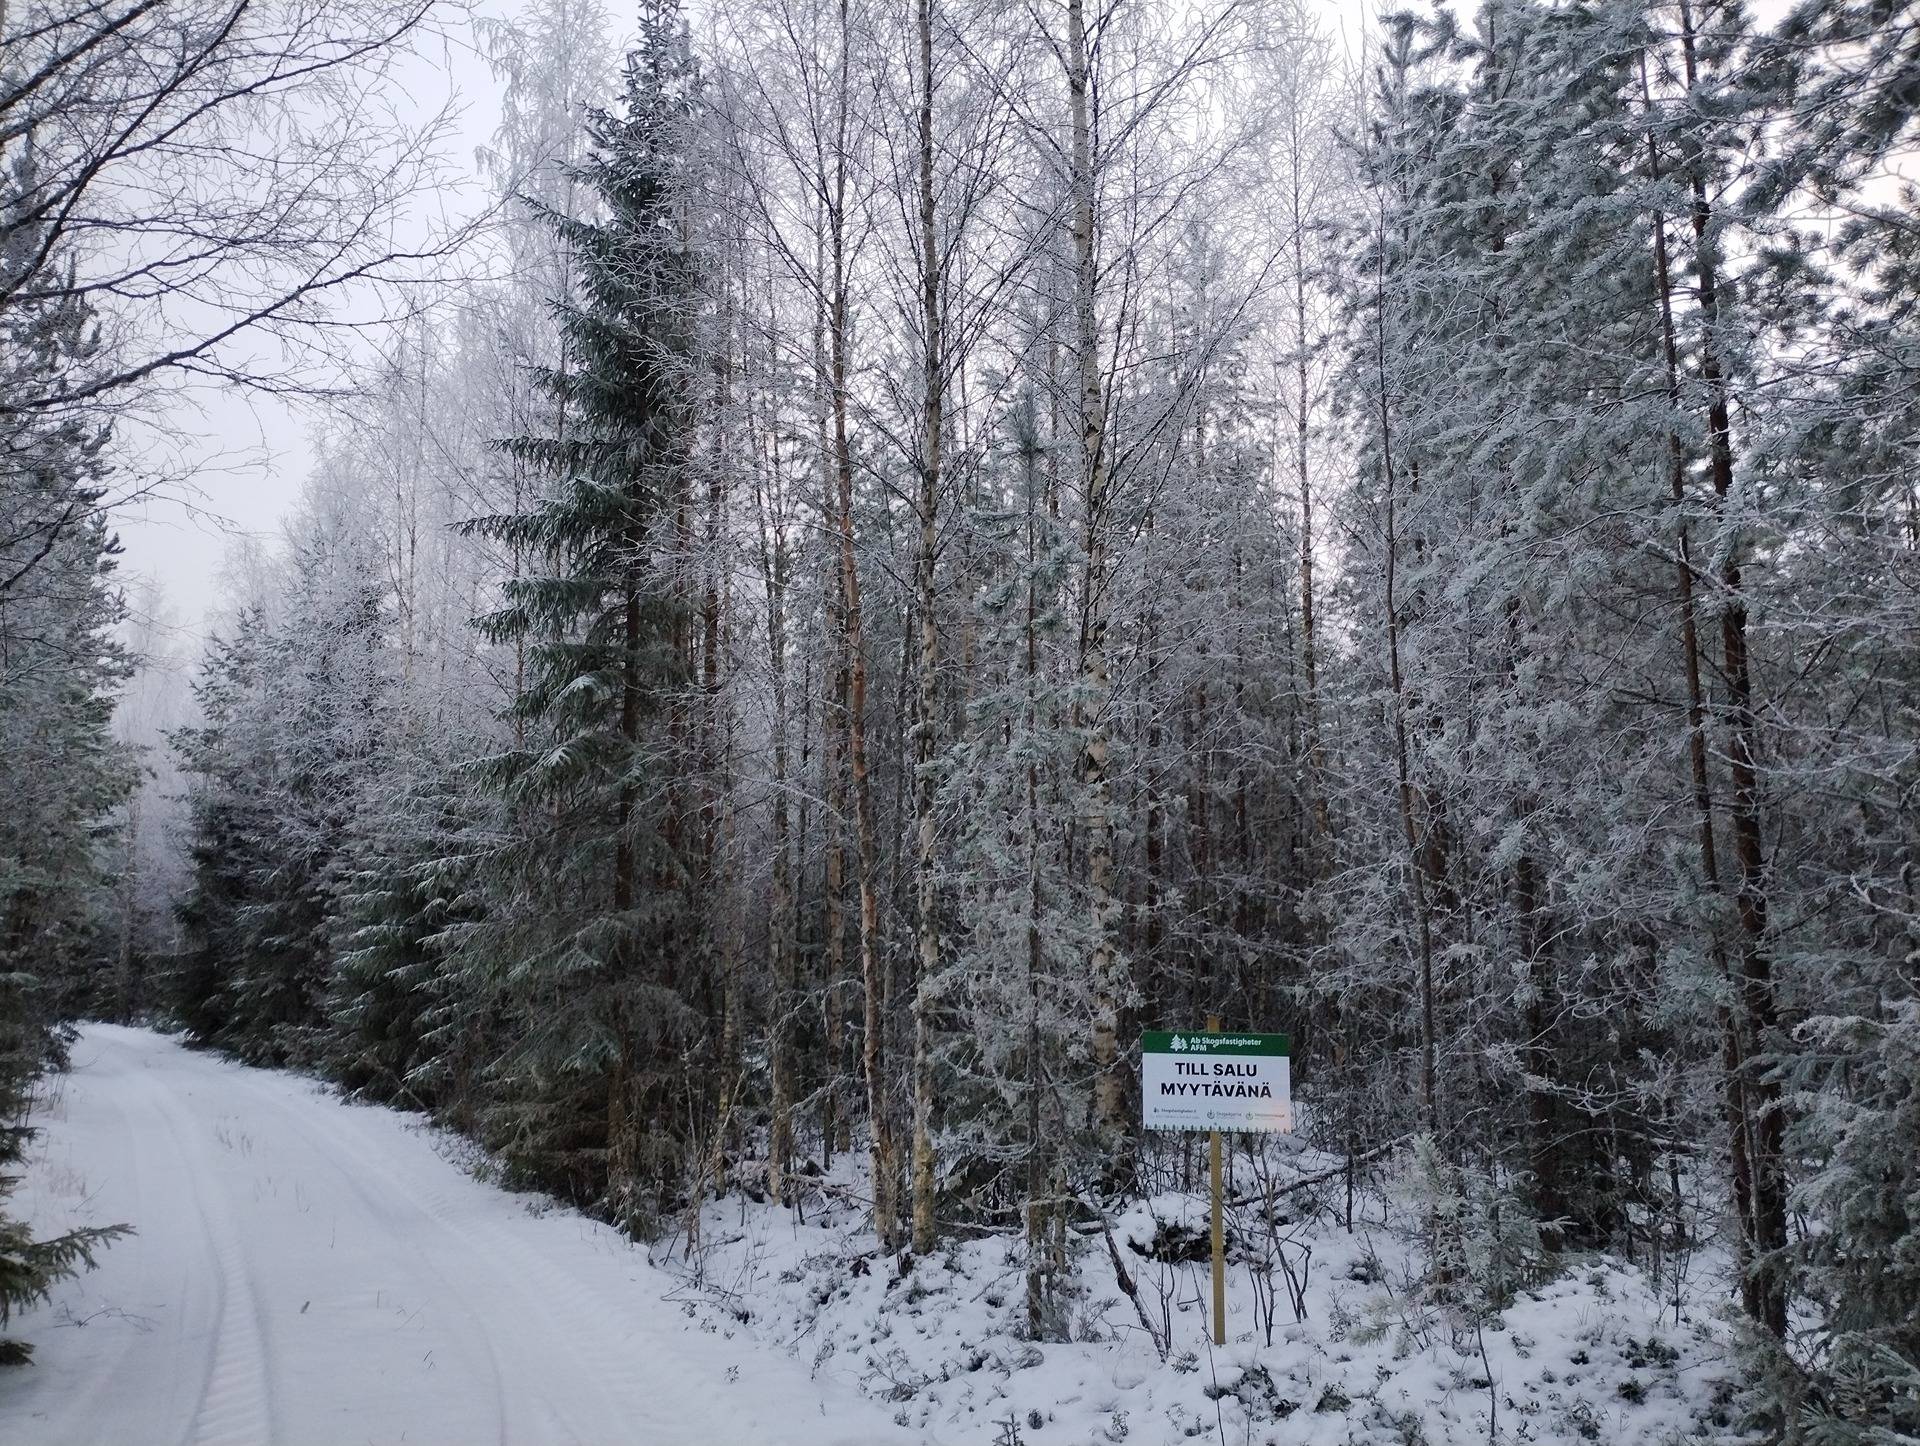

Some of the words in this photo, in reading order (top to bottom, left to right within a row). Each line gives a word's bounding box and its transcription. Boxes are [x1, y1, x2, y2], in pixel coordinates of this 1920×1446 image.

[1201, 1037, 1262, 1048] Skogsfastigheter
[1175, 1062, 1209, 1076] TILL
[1213, 1063, 1257, 1077] SALU
[1160, 1080, 1272, 1098] MYYTÄVÄNÄ
